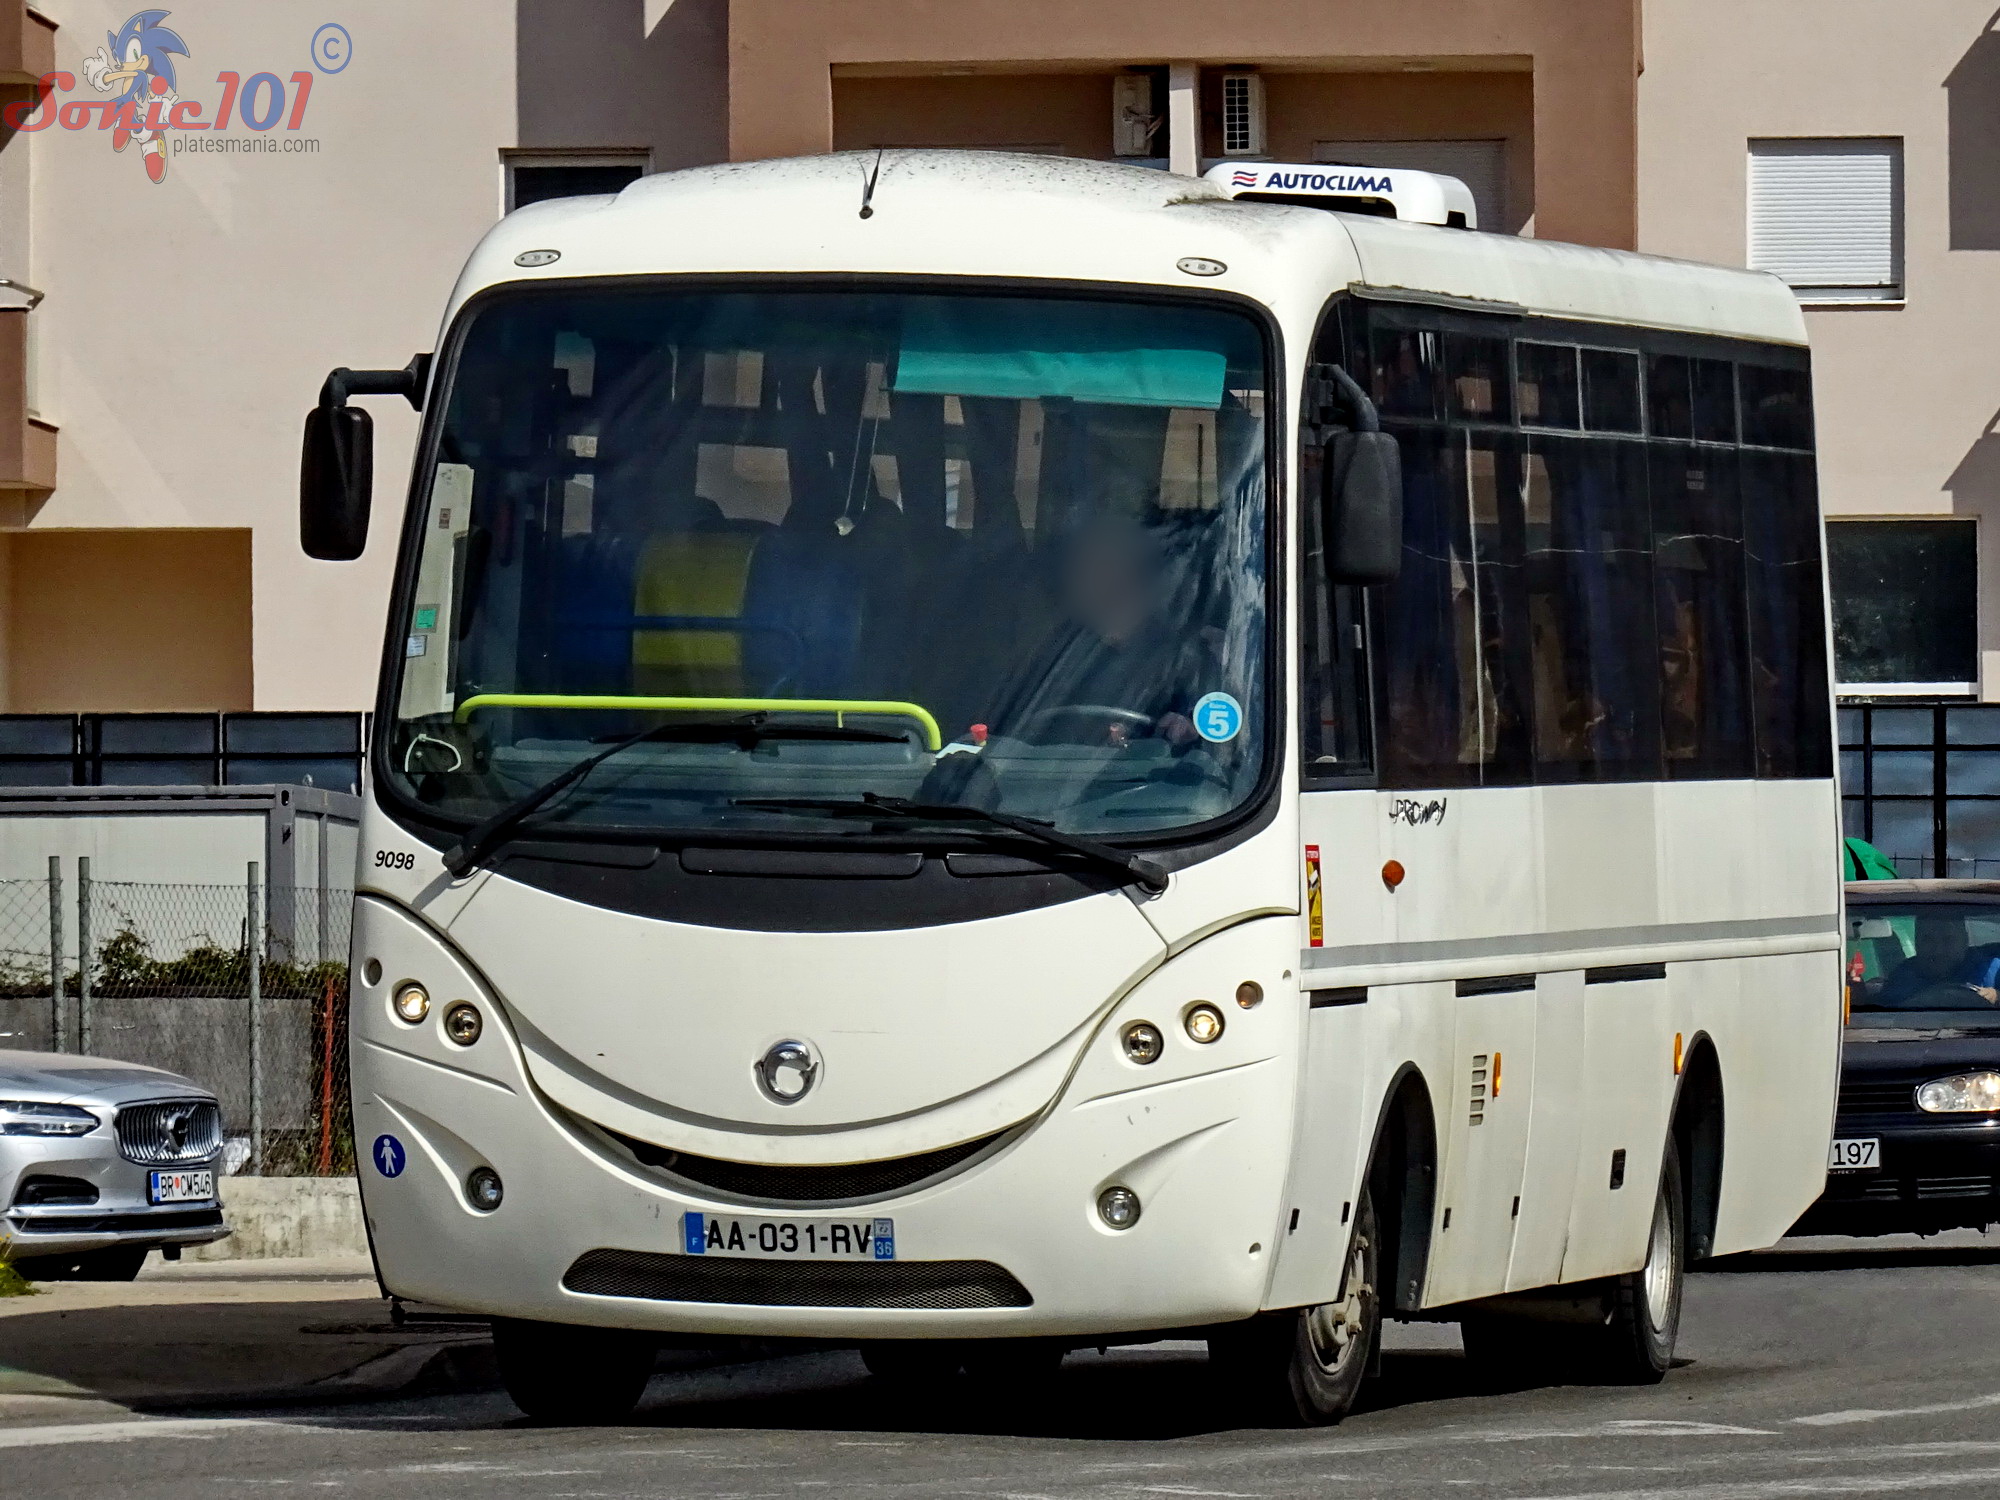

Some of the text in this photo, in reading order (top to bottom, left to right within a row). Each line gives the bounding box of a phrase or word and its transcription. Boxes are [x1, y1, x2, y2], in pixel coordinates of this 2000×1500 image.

[1265, 172, 1393, 193] AUTOCLIMA
[1207, 710, 1229, 736] 5
[375, 850, 415, 870] 9098
[1833, 1142, 1875, 1165] 197
[692, 1237, 698, 1246] F
[707, 1219, 871, 1254] AA-031-RV
[876, 1241, 892, 1256] 36
